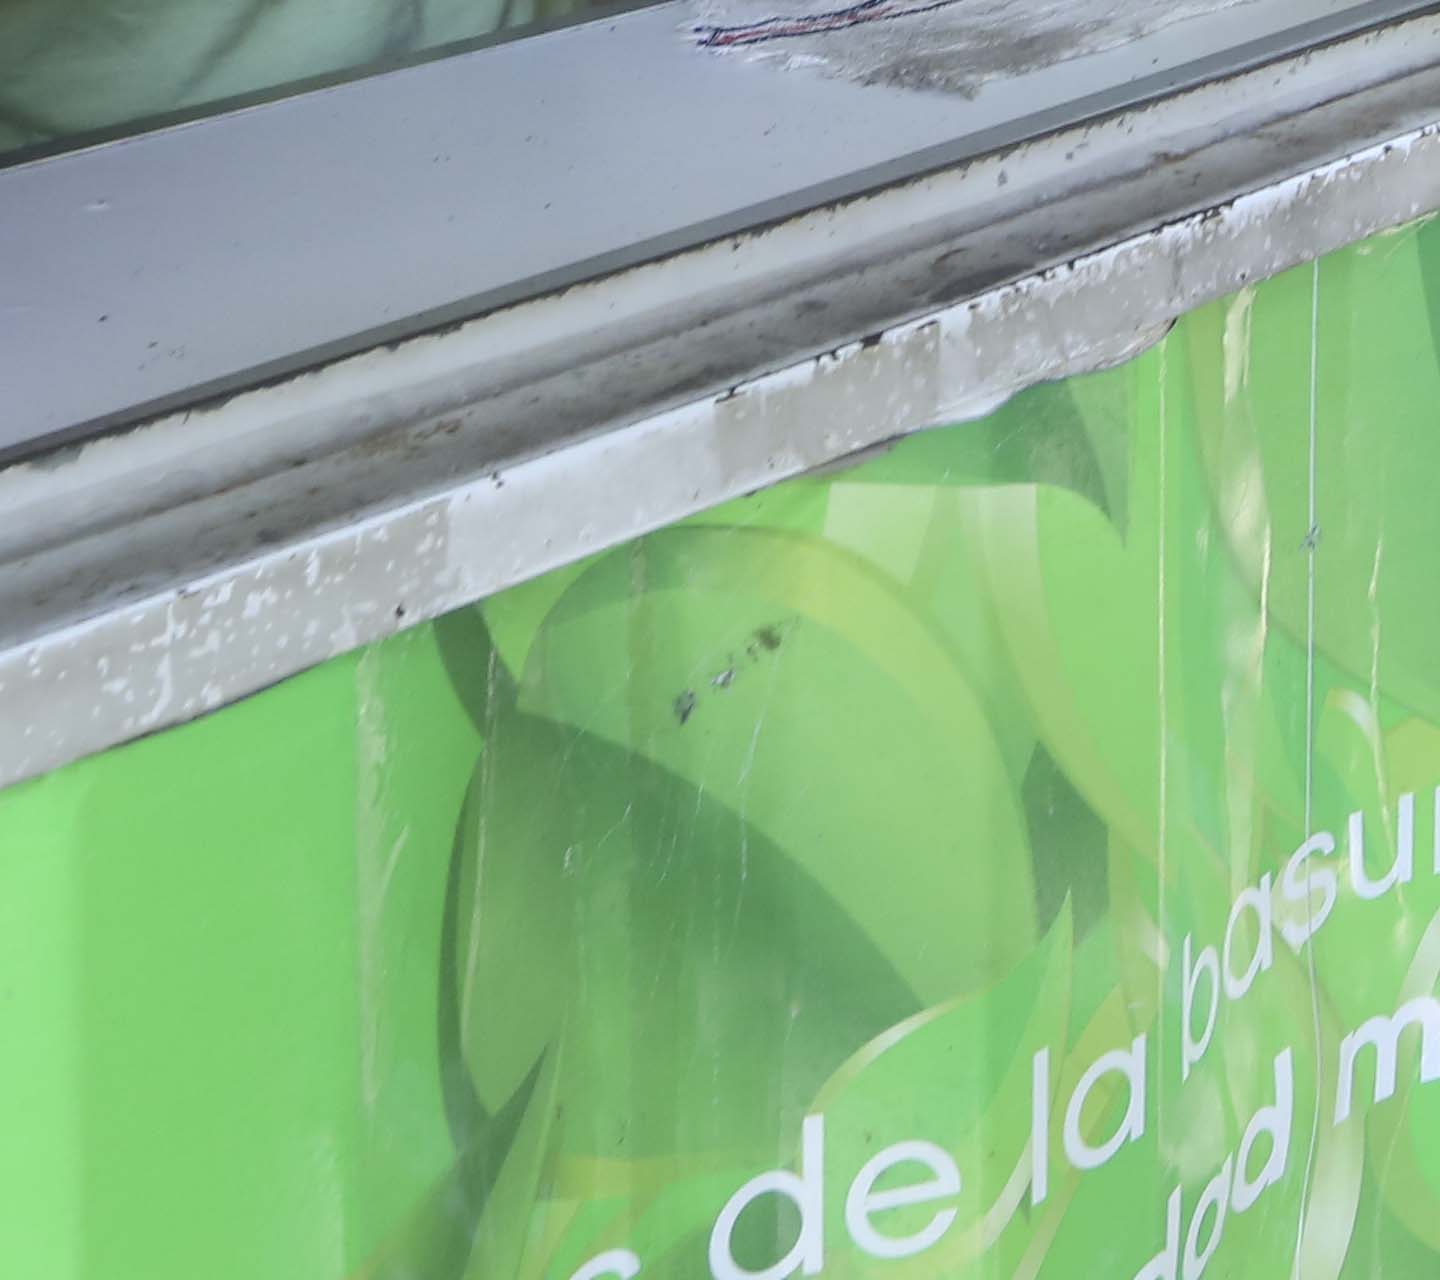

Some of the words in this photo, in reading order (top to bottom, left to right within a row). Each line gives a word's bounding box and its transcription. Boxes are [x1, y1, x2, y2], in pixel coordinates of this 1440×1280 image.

[708, 1113, 962, 1280] de
[1031, 1032, 1146, 1206] la
[1125, 1046, 1294, 1280] dad
